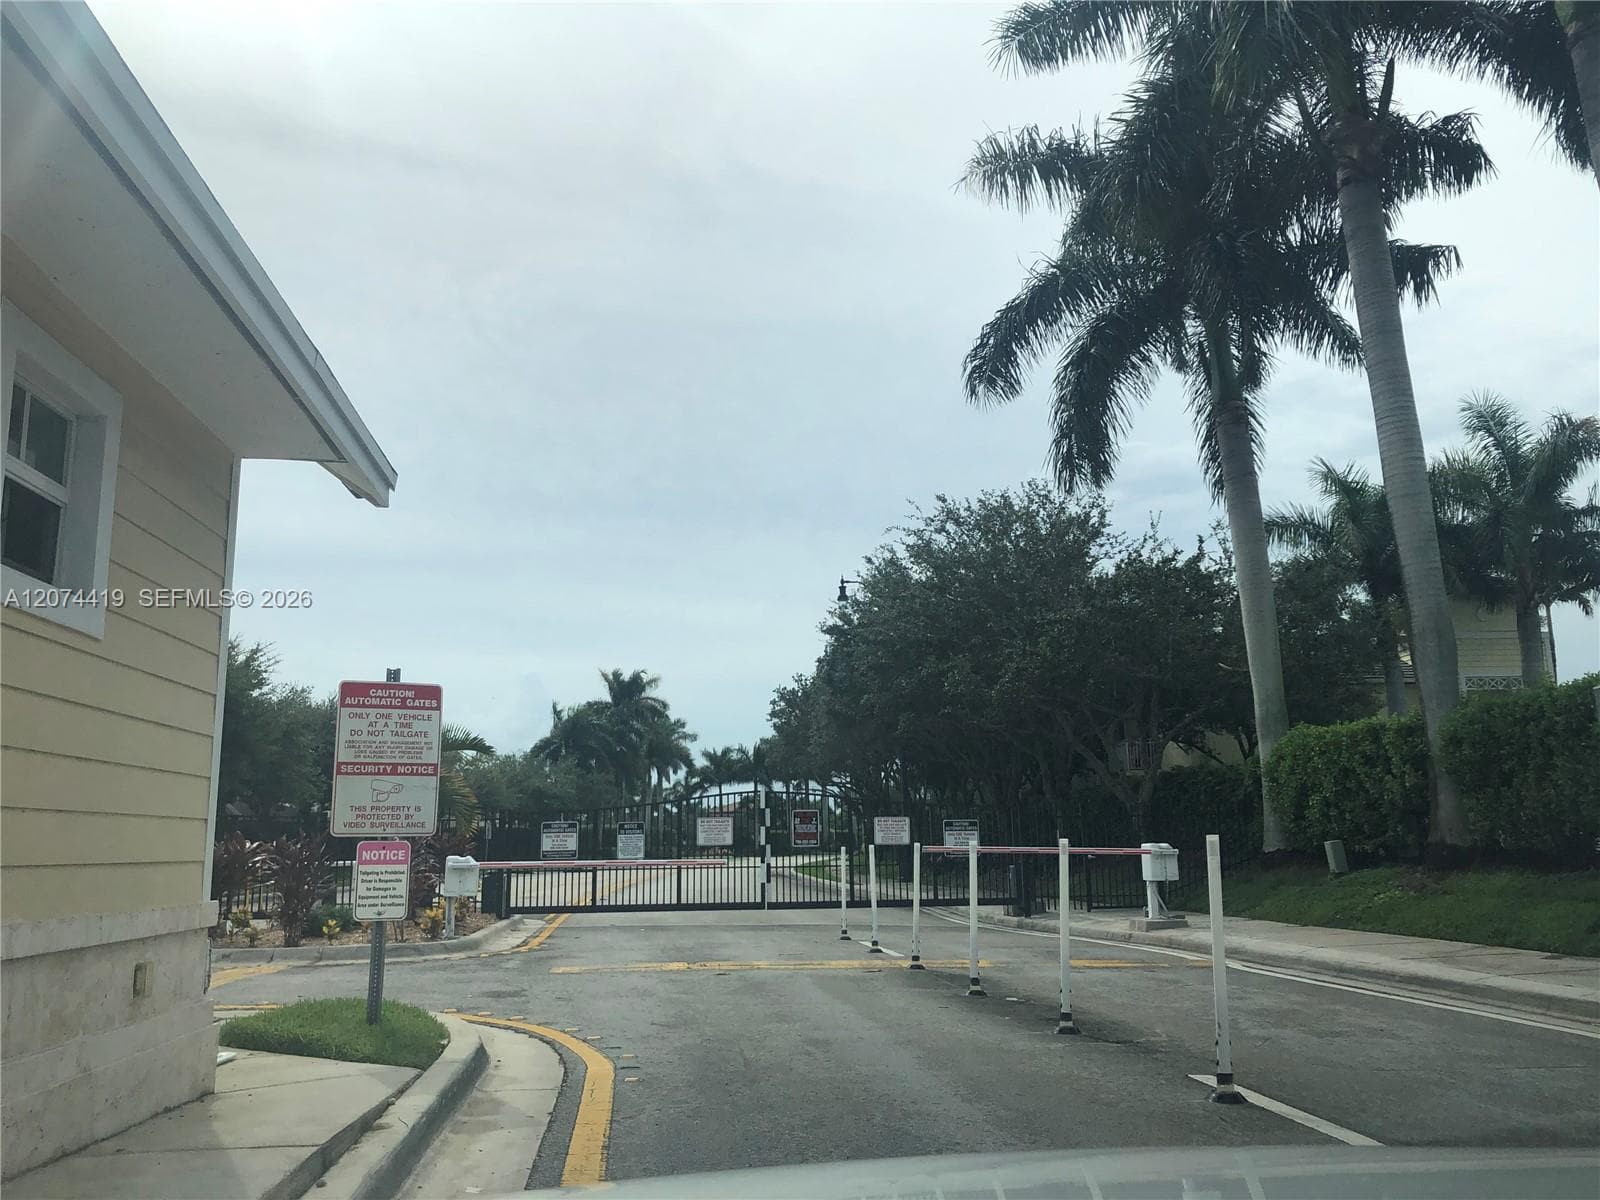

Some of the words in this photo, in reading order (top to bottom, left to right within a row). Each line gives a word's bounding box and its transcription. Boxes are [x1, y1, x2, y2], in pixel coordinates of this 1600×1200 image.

[344, 697, 402, 706] AUTOMATIC
[406, 699, 438, 708] GATES
[348, 711, 371, 720] ONLY
[375, 712, 393, 720] ONE
[397, 713, 433, 722] VEHICLE
[382, 721, 390, 729] A
[394, 721, 414, 730] TIME
[350, 729, 364, 737] DO
[367, 729, 385, 738] NOT
[390, 730, 430, 739] TAILGATE
[340, 764, 392, 774] SECURITY
[397, 766, 434, 774] NOTICE
[343, 822, 366, 830] VIDEO
[370, 822, 426, 830] SURVEILLANCE
[362, 850, 406, 860] NOTICE
